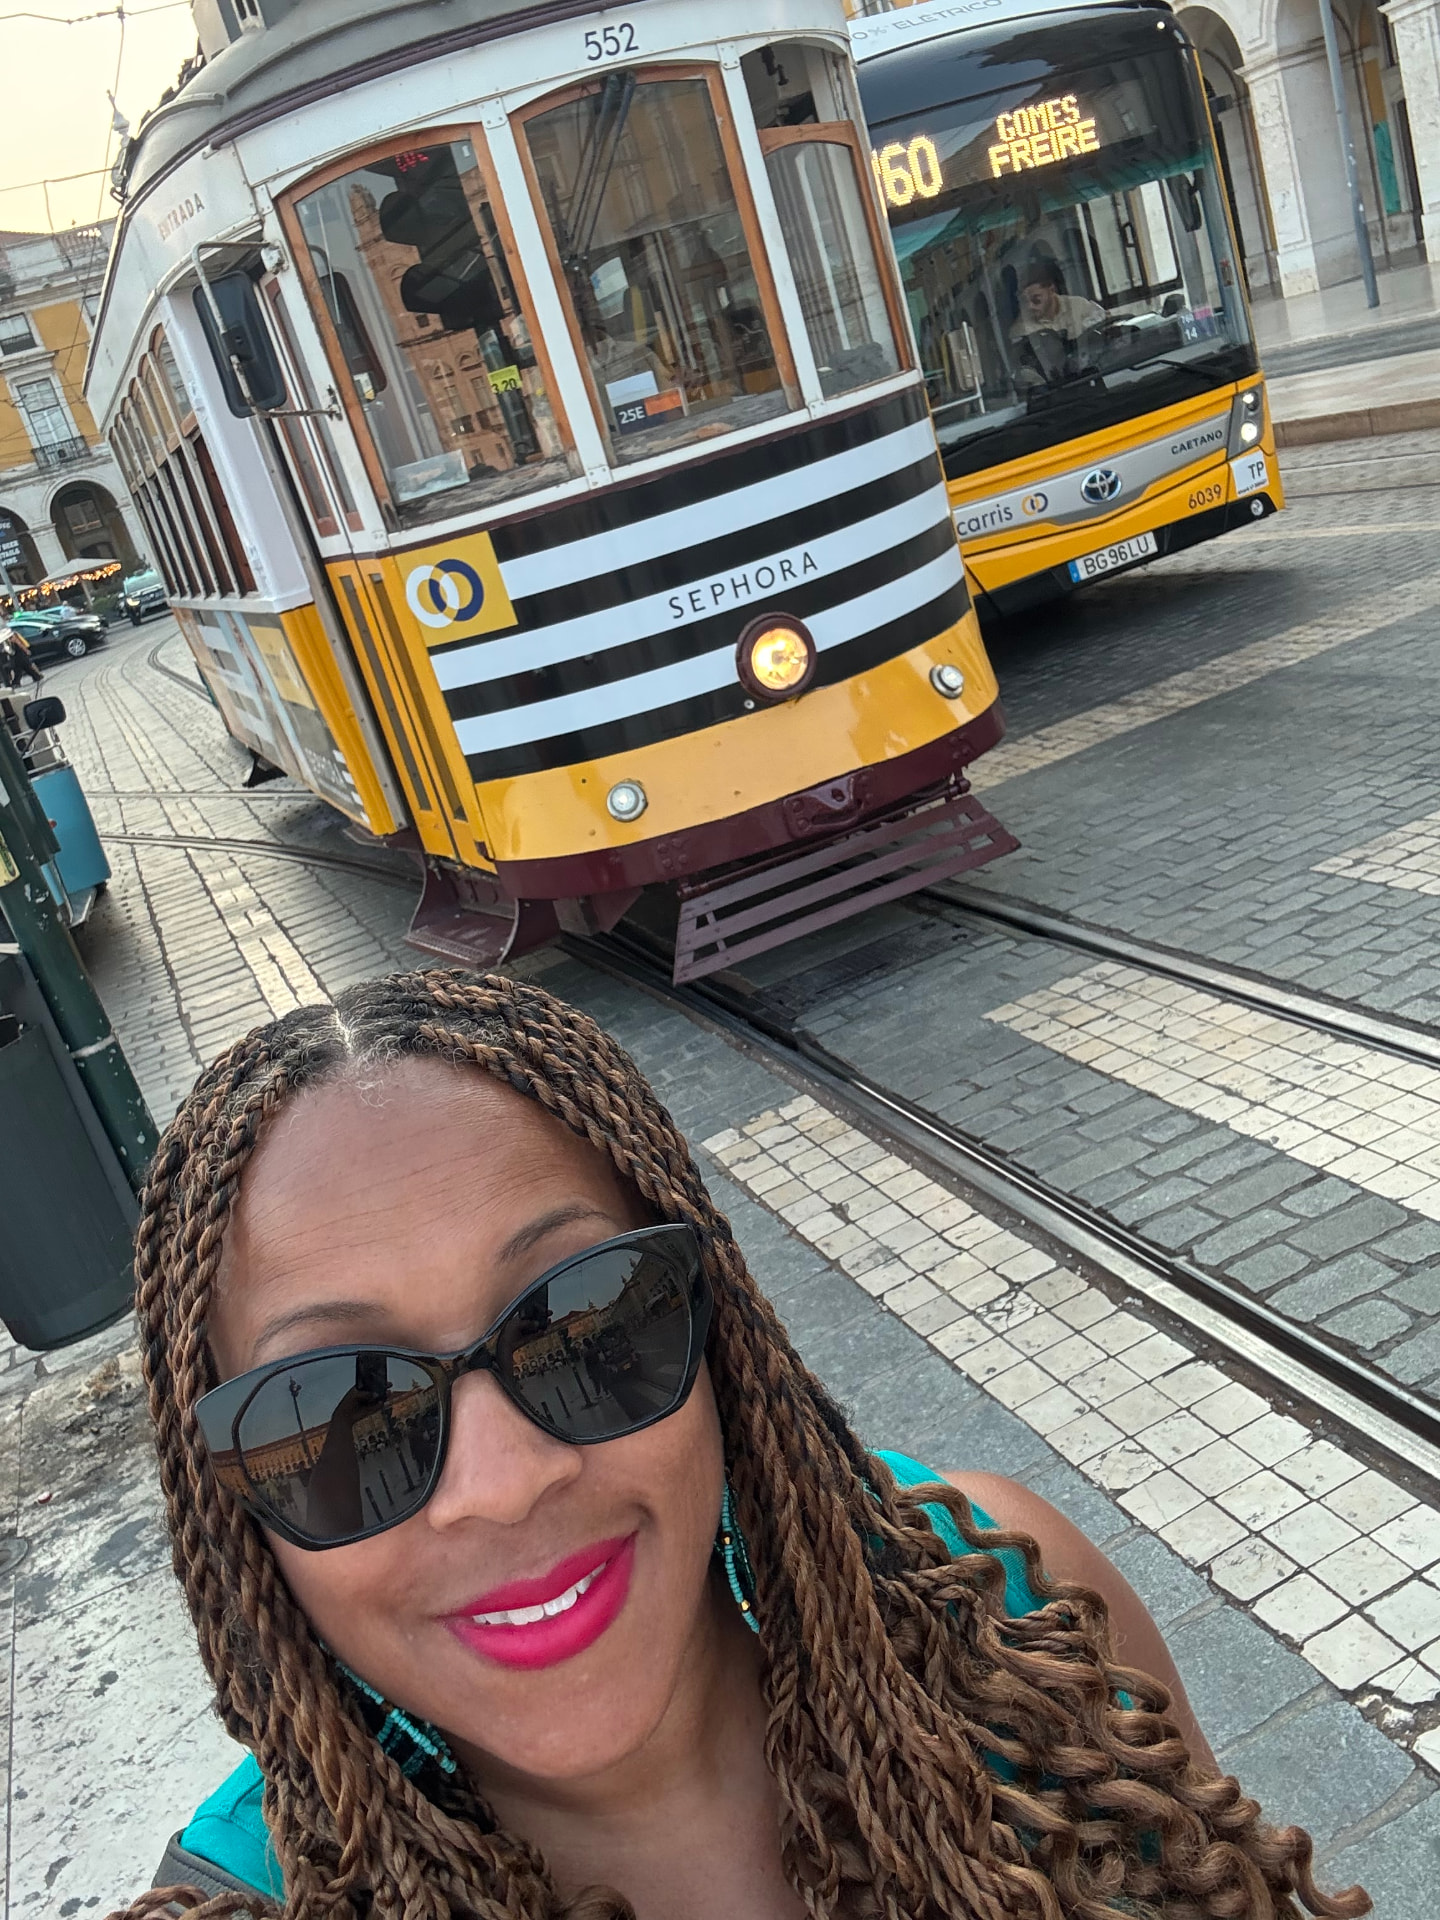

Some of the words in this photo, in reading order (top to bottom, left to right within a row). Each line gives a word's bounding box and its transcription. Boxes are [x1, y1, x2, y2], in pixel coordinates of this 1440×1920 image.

[584, 22, 640, 61] 552
[995, 93, 1082, 143] GOMES
[987, 117, 1101, 179] FREIRE
[618, 405, 646, 425] 25E
[1170, 429, 1223, 455] CAETANO
[1247, 460, 1265, 480] TP
[1188, 483, 1222, 510] 6039
[956, 504, 1013, 537] carris
[668, 551, 819, 620] SEPHORA
